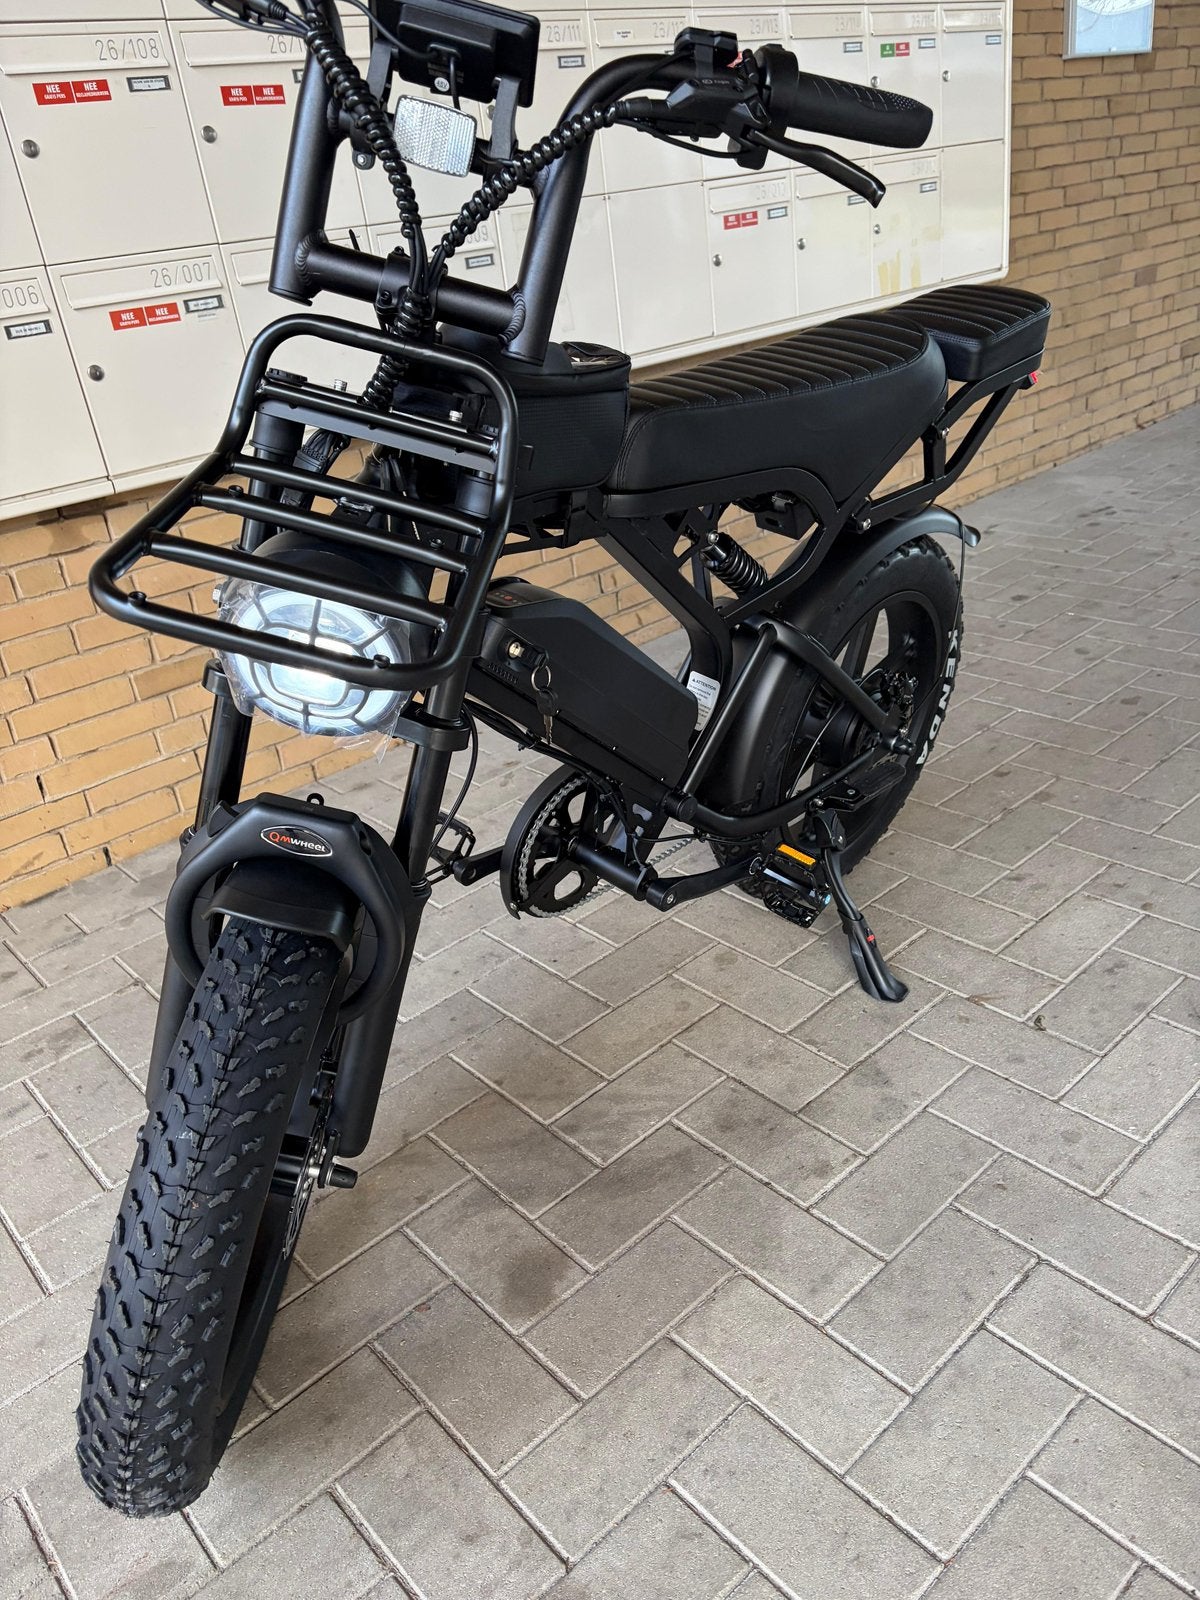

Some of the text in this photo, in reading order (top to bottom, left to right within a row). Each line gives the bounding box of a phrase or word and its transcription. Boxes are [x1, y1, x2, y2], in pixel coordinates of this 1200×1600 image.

[267, 34, 307, 54] 26/1
[95, 38, 159, 60] 26/108
[45, 84, 61, 93] NEE
[83, 82, 99, 91] NEE
[230, 88, 243, 96] NEE
[262, 87, 275, 96] NEE
[150, 262, 210, 288] 26/007
[2, 285, 39, 308] 006
[155, 307, 169, 316] NEE
[121, 312, 135, 321] NEE
[916, 629, 959, 765] KENDA
